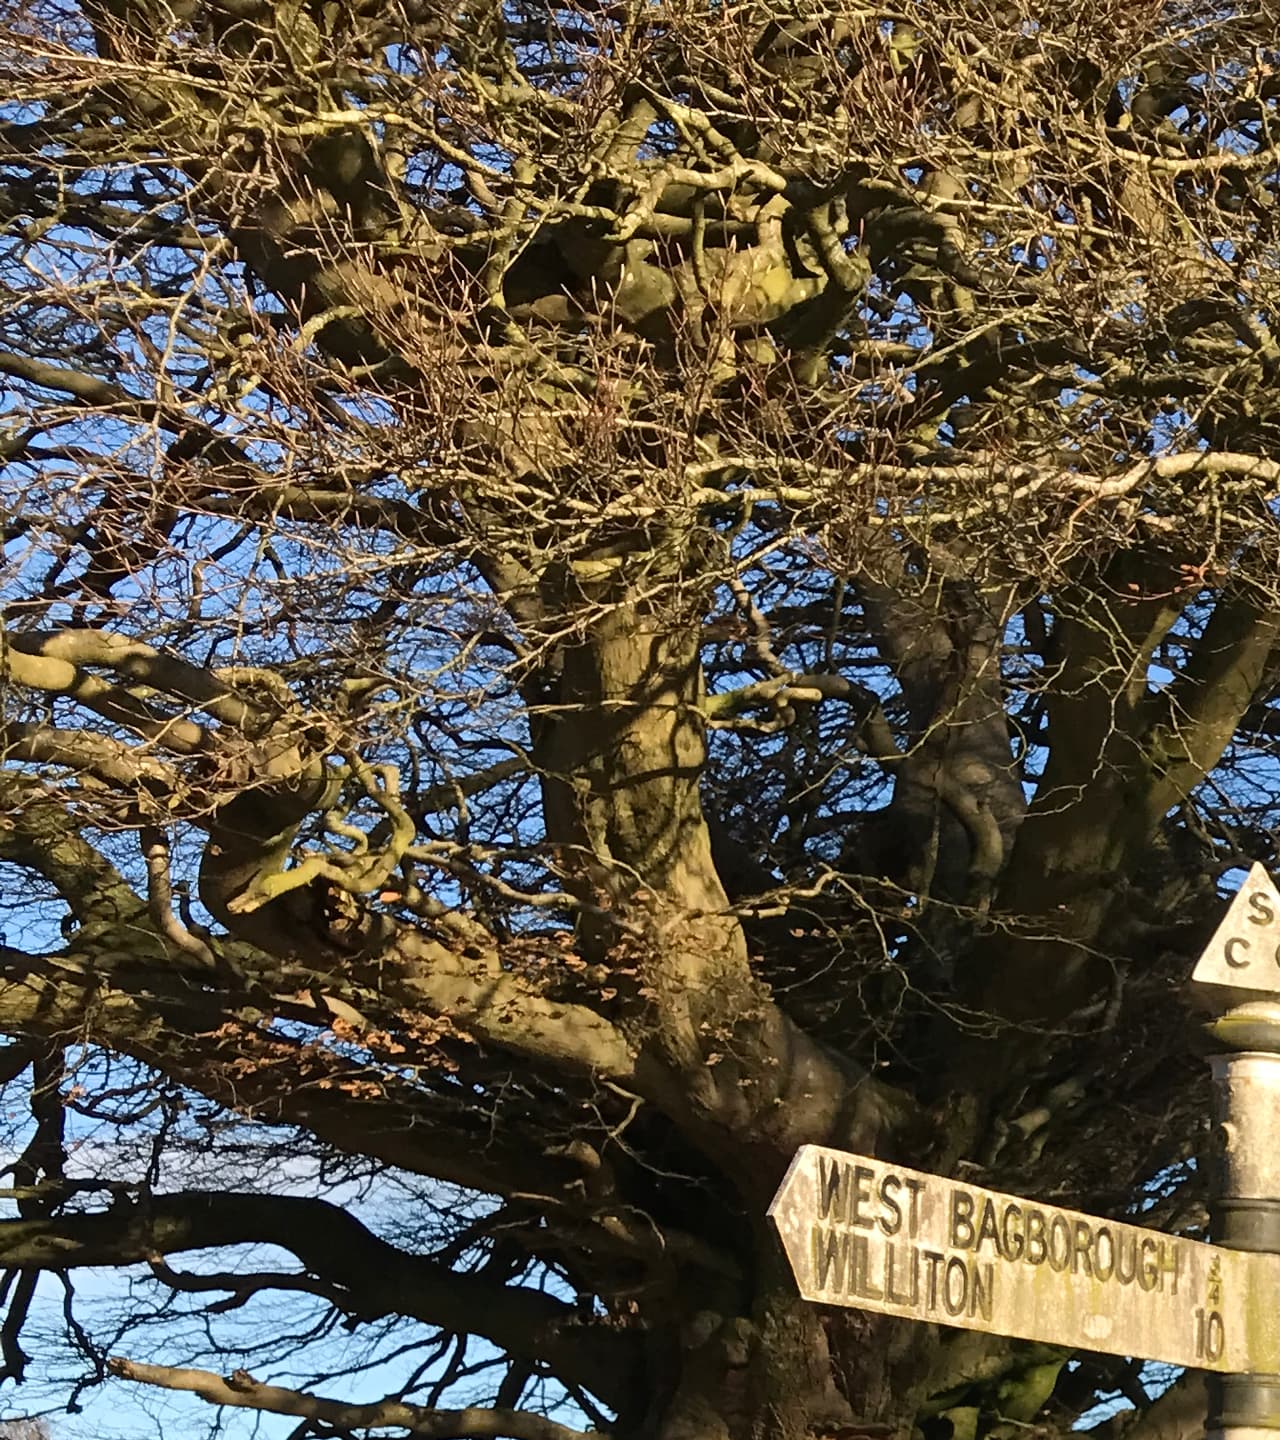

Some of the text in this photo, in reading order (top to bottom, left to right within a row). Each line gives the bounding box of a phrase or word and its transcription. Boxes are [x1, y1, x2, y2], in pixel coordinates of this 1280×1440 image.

[1247, 891, 1275, 926] S
[1223, 936, 1251, 969] C
[816, 1155, 926, 1240] WEST
[949, 1188, 1180, 1296] BAGBOROUGH
[811, 1227, 1225, 1363] WILLITON 10
